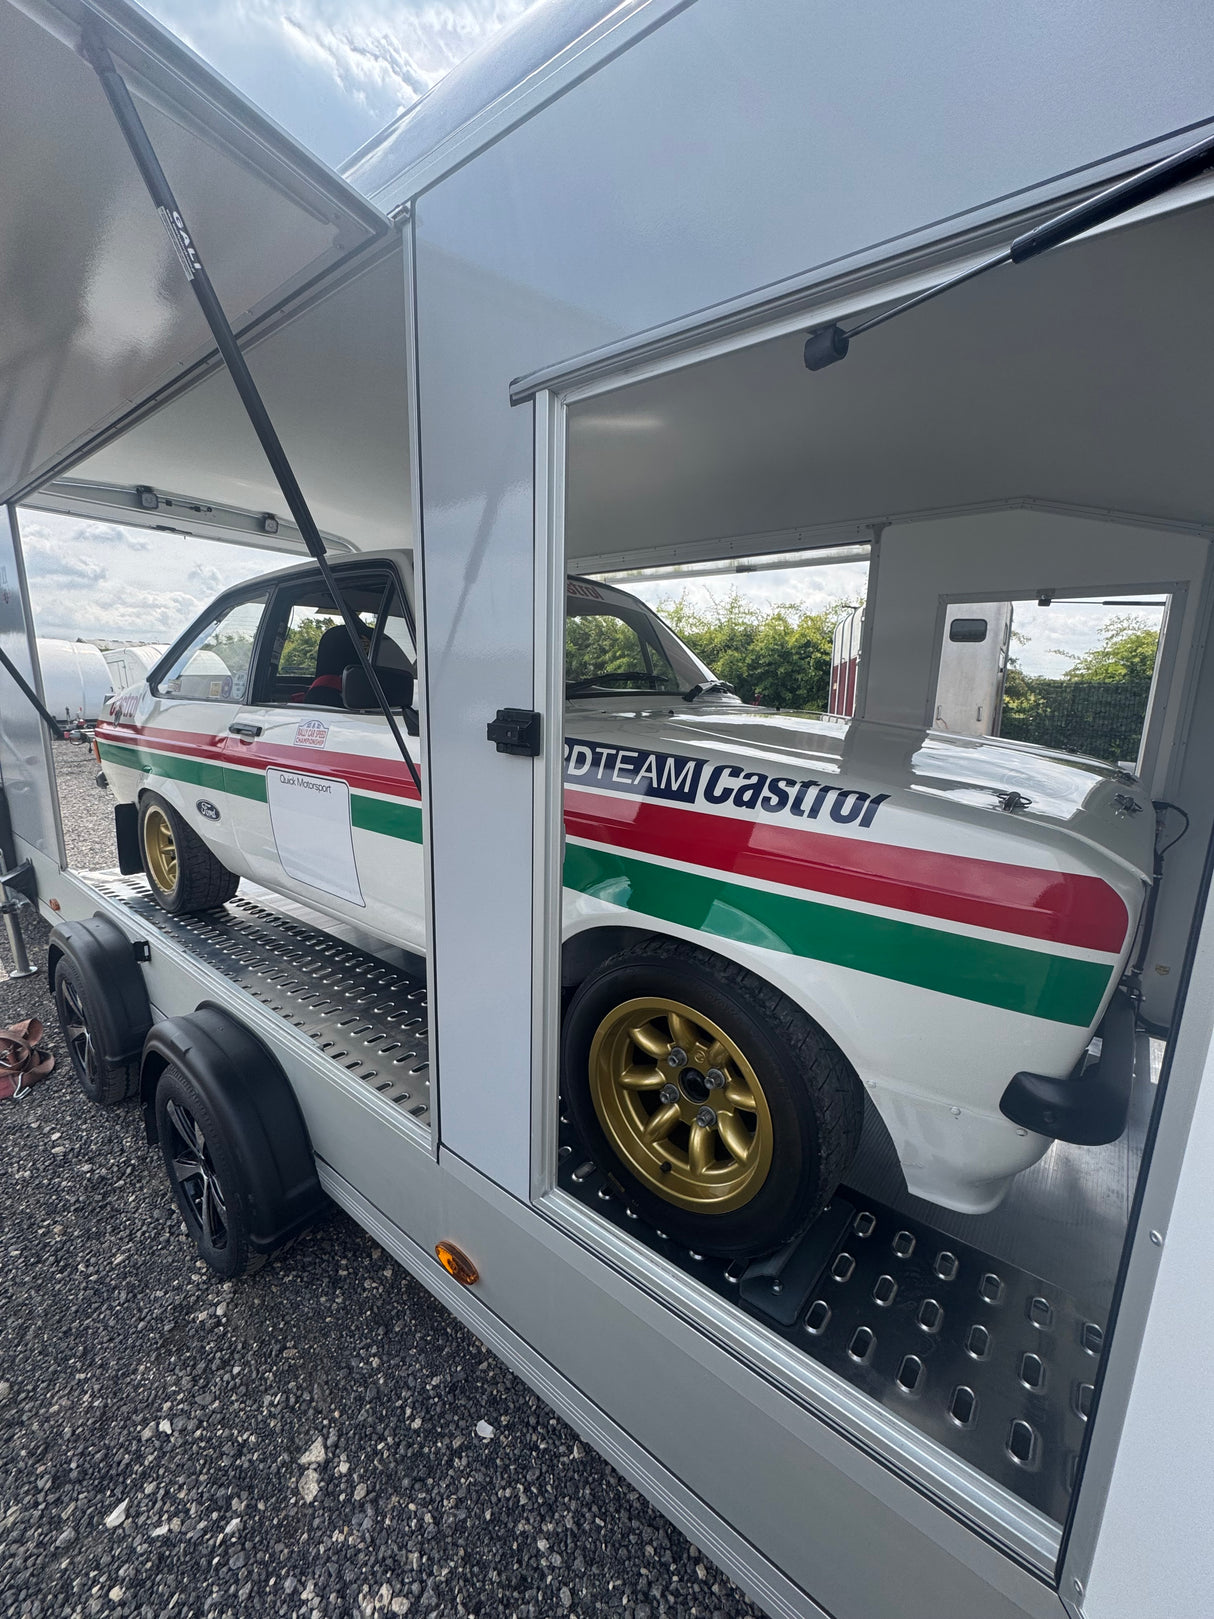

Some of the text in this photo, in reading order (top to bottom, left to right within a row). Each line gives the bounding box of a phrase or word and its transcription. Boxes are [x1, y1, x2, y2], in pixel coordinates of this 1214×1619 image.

[173, 211, 202, 269] GALI
[279, 774, 332, 794] Quick Motorsport
[703, 764, 892, 829] Castrol
[200, 802, 217, 819] Ford
